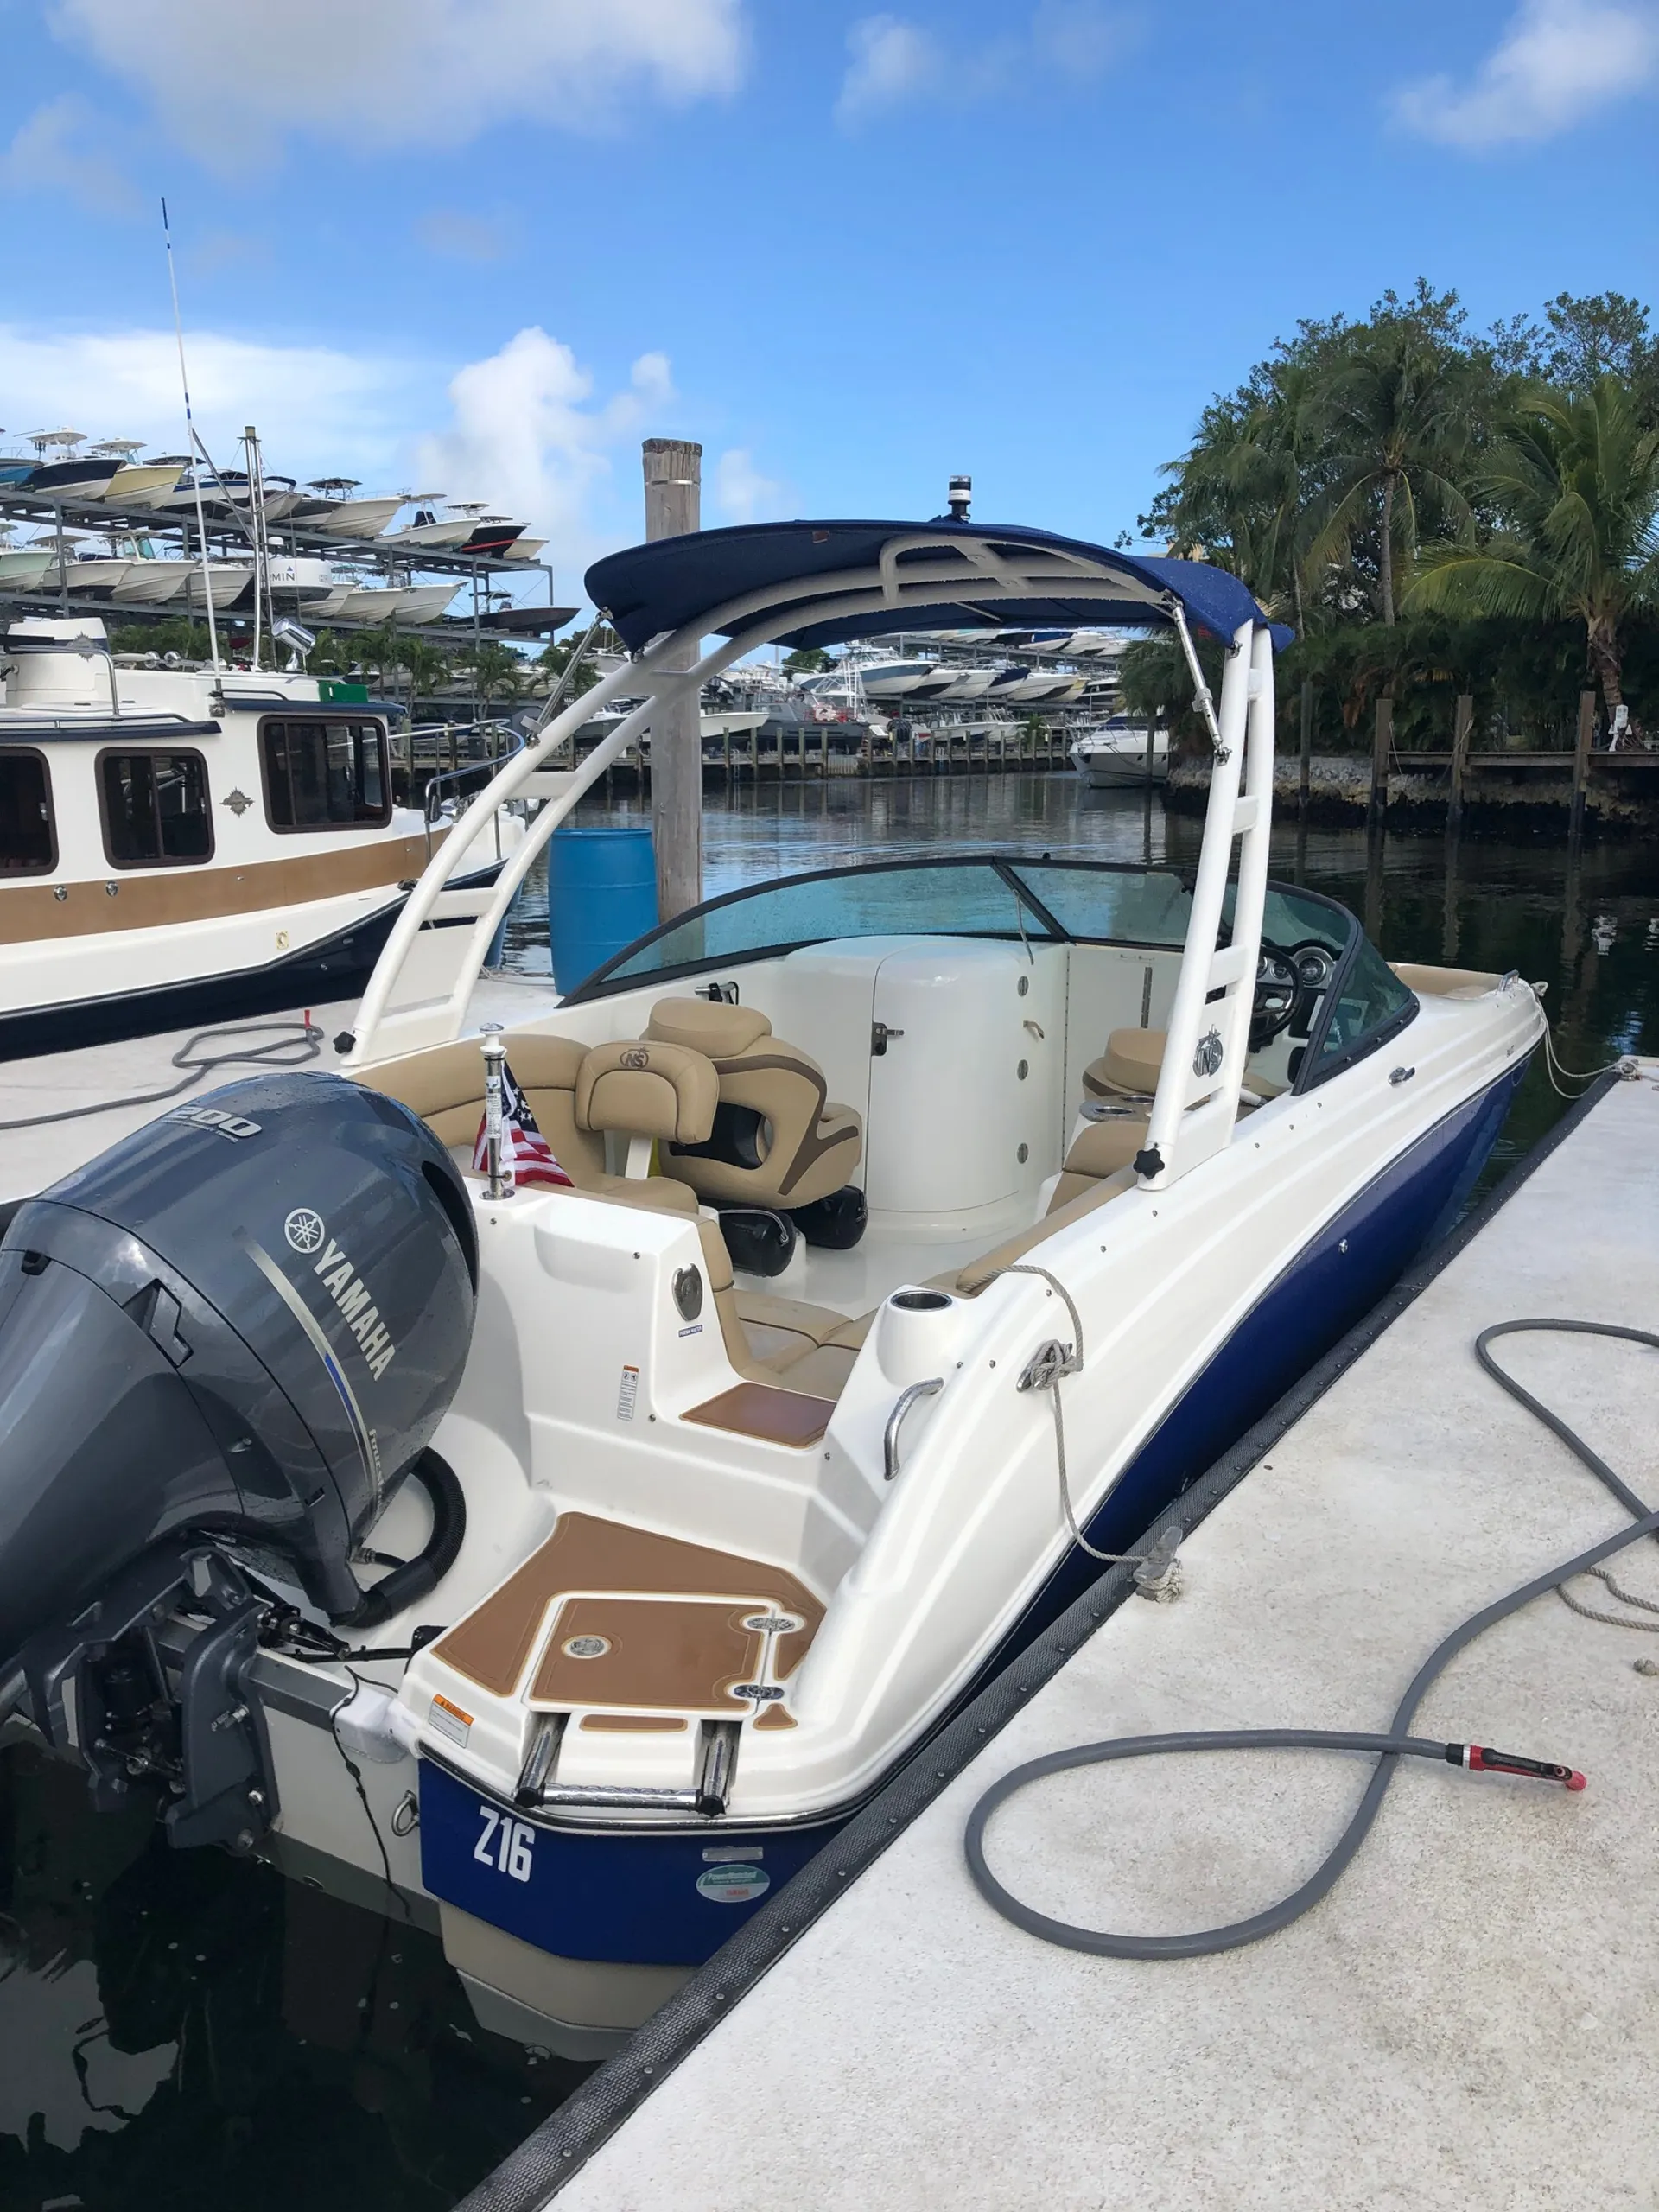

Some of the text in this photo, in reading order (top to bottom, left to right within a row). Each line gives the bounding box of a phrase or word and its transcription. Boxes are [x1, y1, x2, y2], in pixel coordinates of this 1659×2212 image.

[163, 1106, 263, 1137] 200
[313, 1238, 397, 1382] YAMAHA
[474, 1804, 536, 1883] Z16
